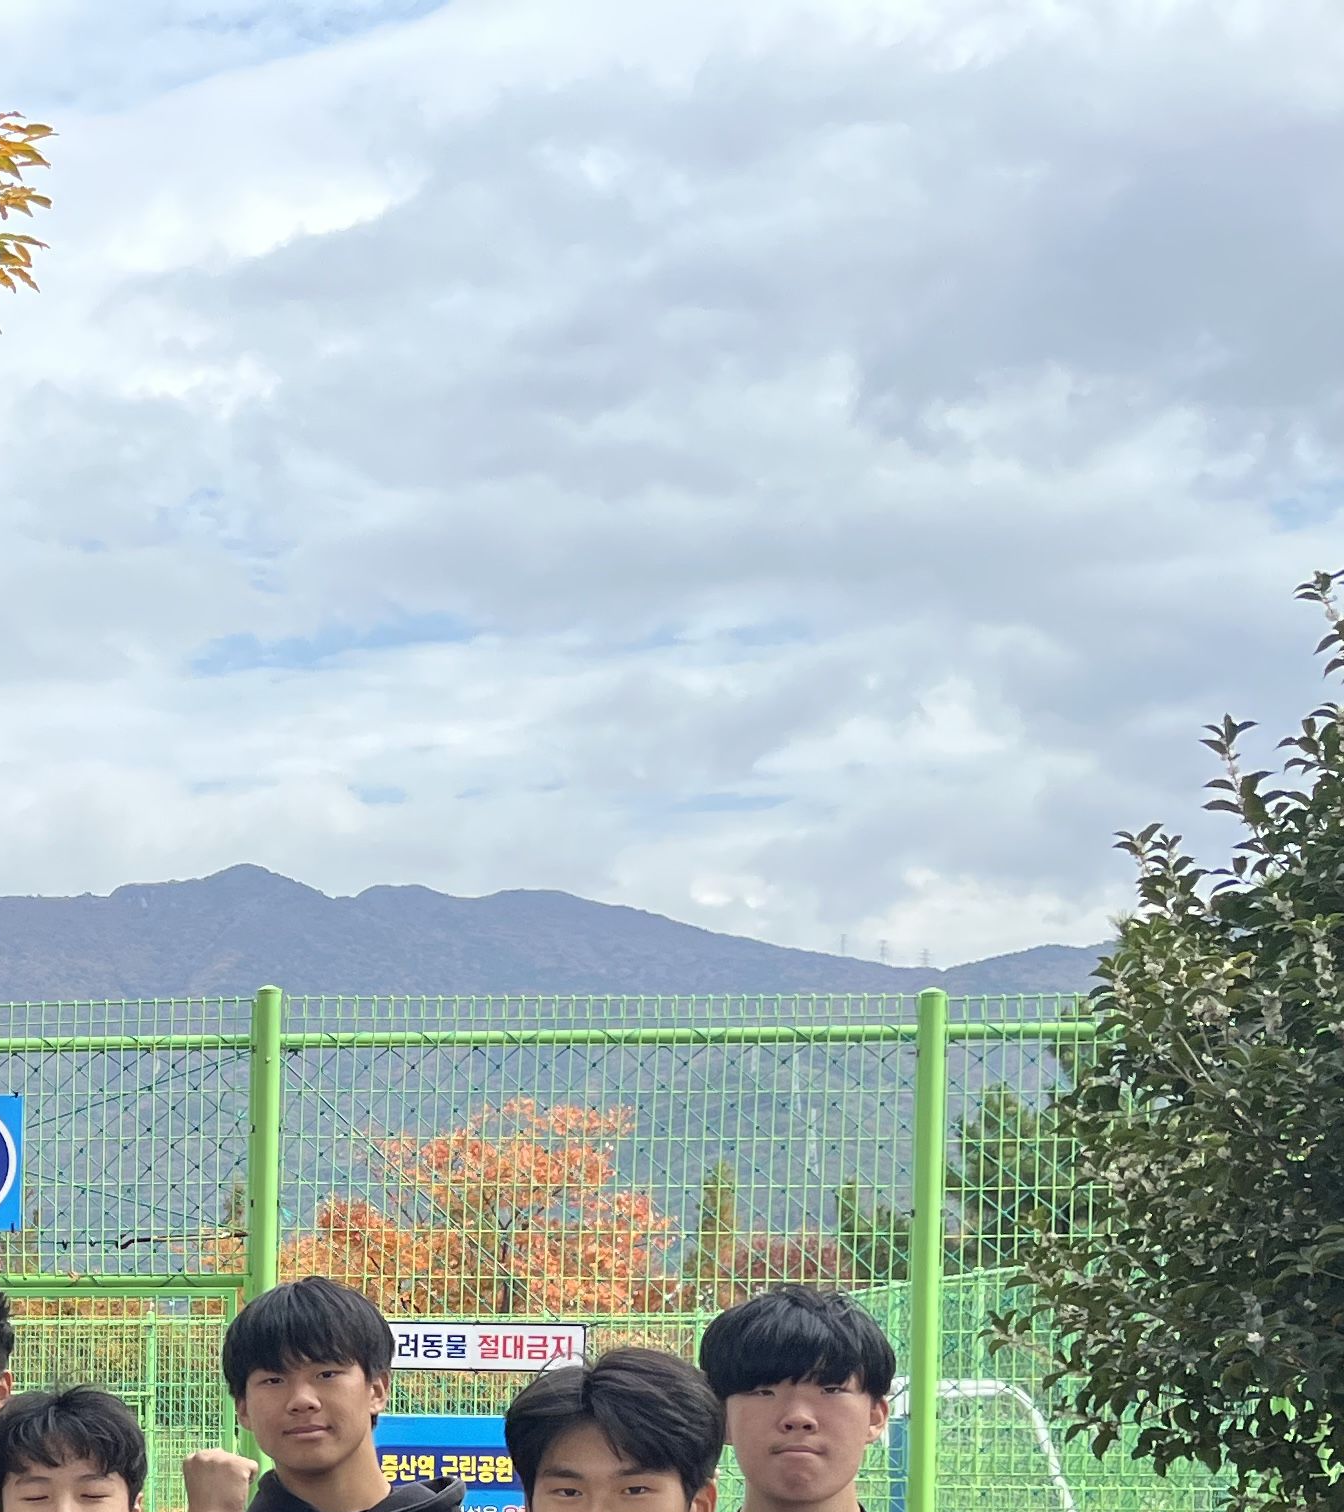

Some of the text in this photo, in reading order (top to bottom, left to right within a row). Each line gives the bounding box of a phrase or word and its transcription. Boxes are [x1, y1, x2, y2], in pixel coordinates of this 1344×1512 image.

[477, 1334, 573, 1361] 절대금지
[380, 1454, 514, 1483] 증산역 근린공원
